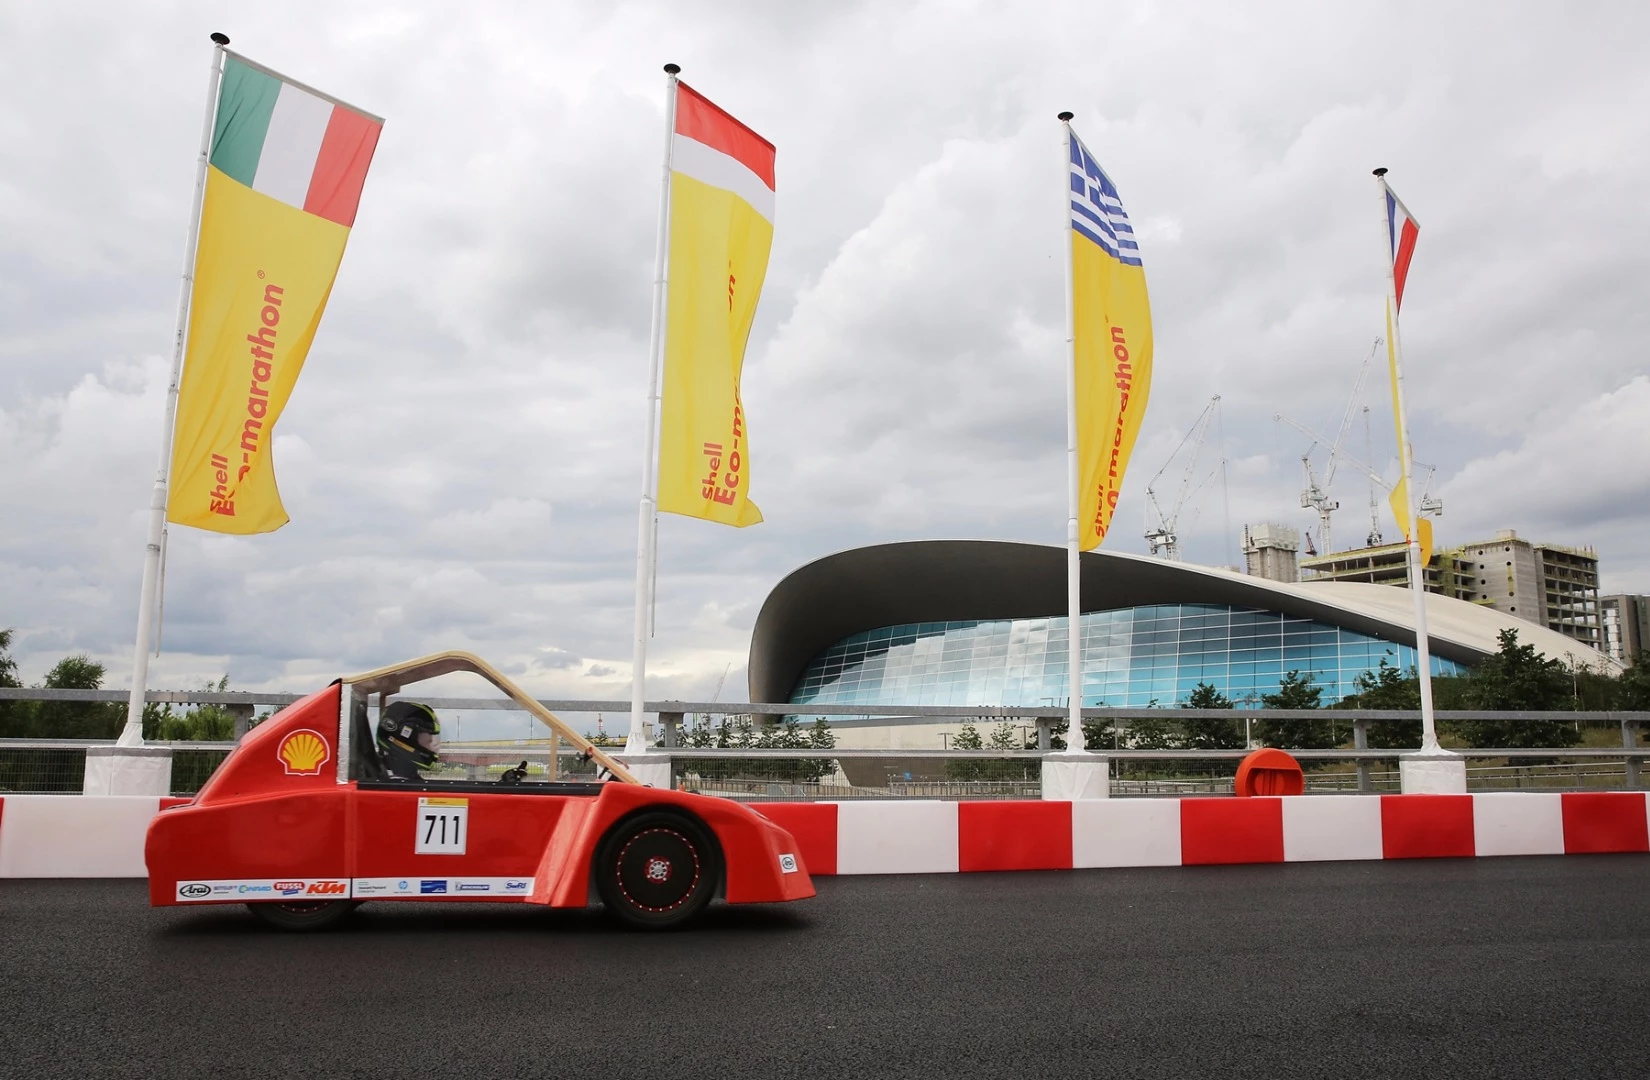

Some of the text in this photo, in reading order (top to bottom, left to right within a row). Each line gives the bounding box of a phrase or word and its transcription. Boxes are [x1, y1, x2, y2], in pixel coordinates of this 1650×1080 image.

[216, 284, 284, 516] E-marathon
[1106, 326, 1132, 533] o-marathon
[210, 453, 228, 512] Shell
[702, 442, 723, 500] Shell
[424, 815, 460, 845] 711
[306, 881, 347, 894] KTM
